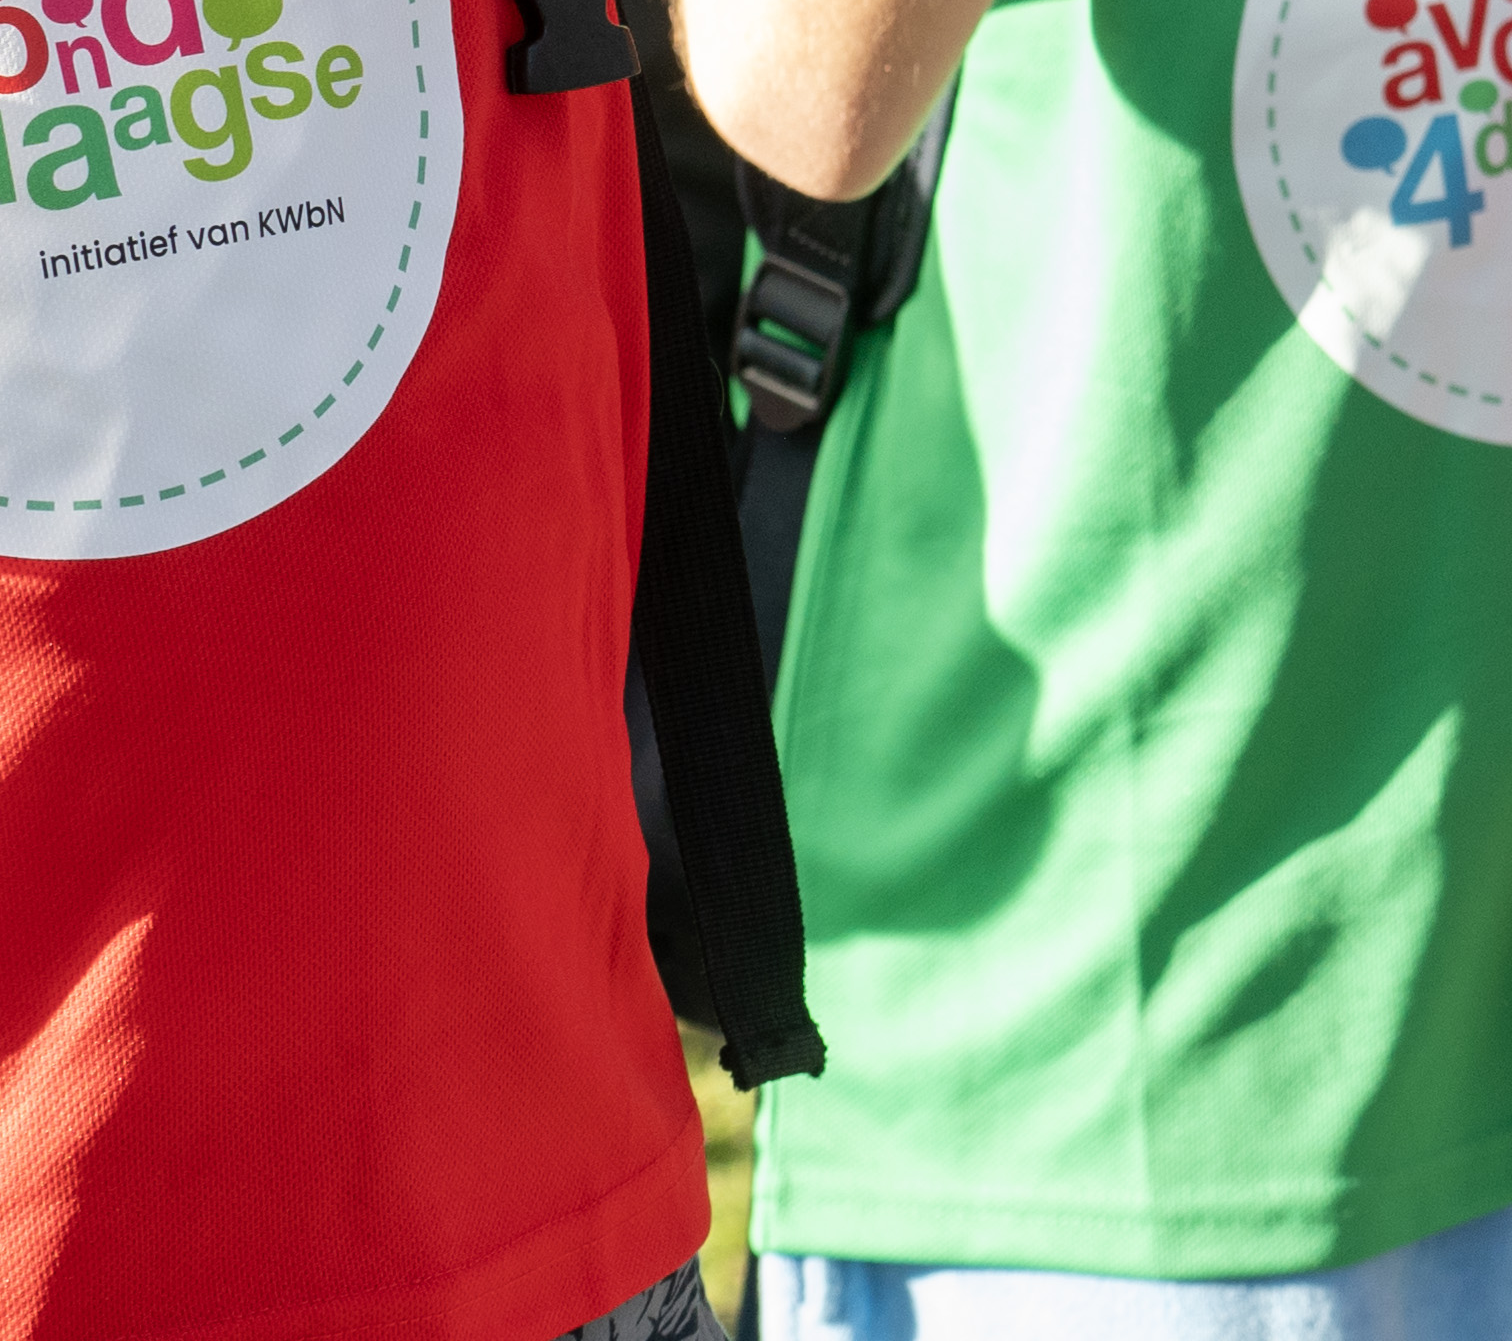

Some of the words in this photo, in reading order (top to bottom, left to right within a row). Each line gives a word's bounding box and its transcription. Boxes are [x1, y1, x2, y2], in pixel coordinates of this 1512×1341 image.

[0, 40, 365, 212] aagse
[38, 224, 180, 280] initiatief
[186, 217, 250, 251] van
[258, 196, 346, 238] KWbN
